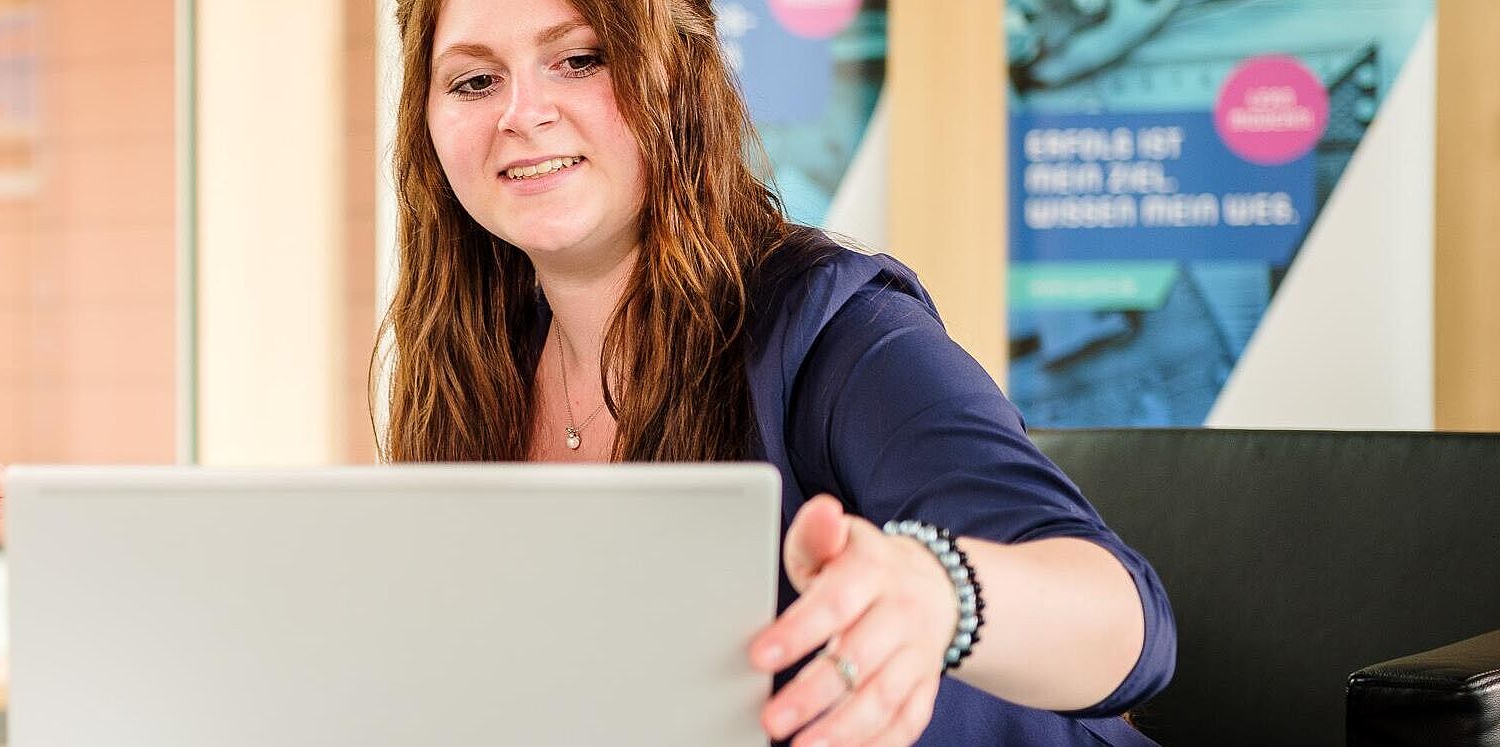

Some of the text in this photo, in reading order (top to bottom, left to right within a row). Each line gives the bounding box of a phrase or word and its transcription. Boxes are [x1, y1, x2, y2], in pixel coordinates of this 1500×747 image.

[1025, 127, 1183, 161] ERFOLG IST
[1025, 162, 1103, 195] MEIN
[1025, 194, 1137, 229] WISSEN
[1139, 193, 1219, 227] MEIN
